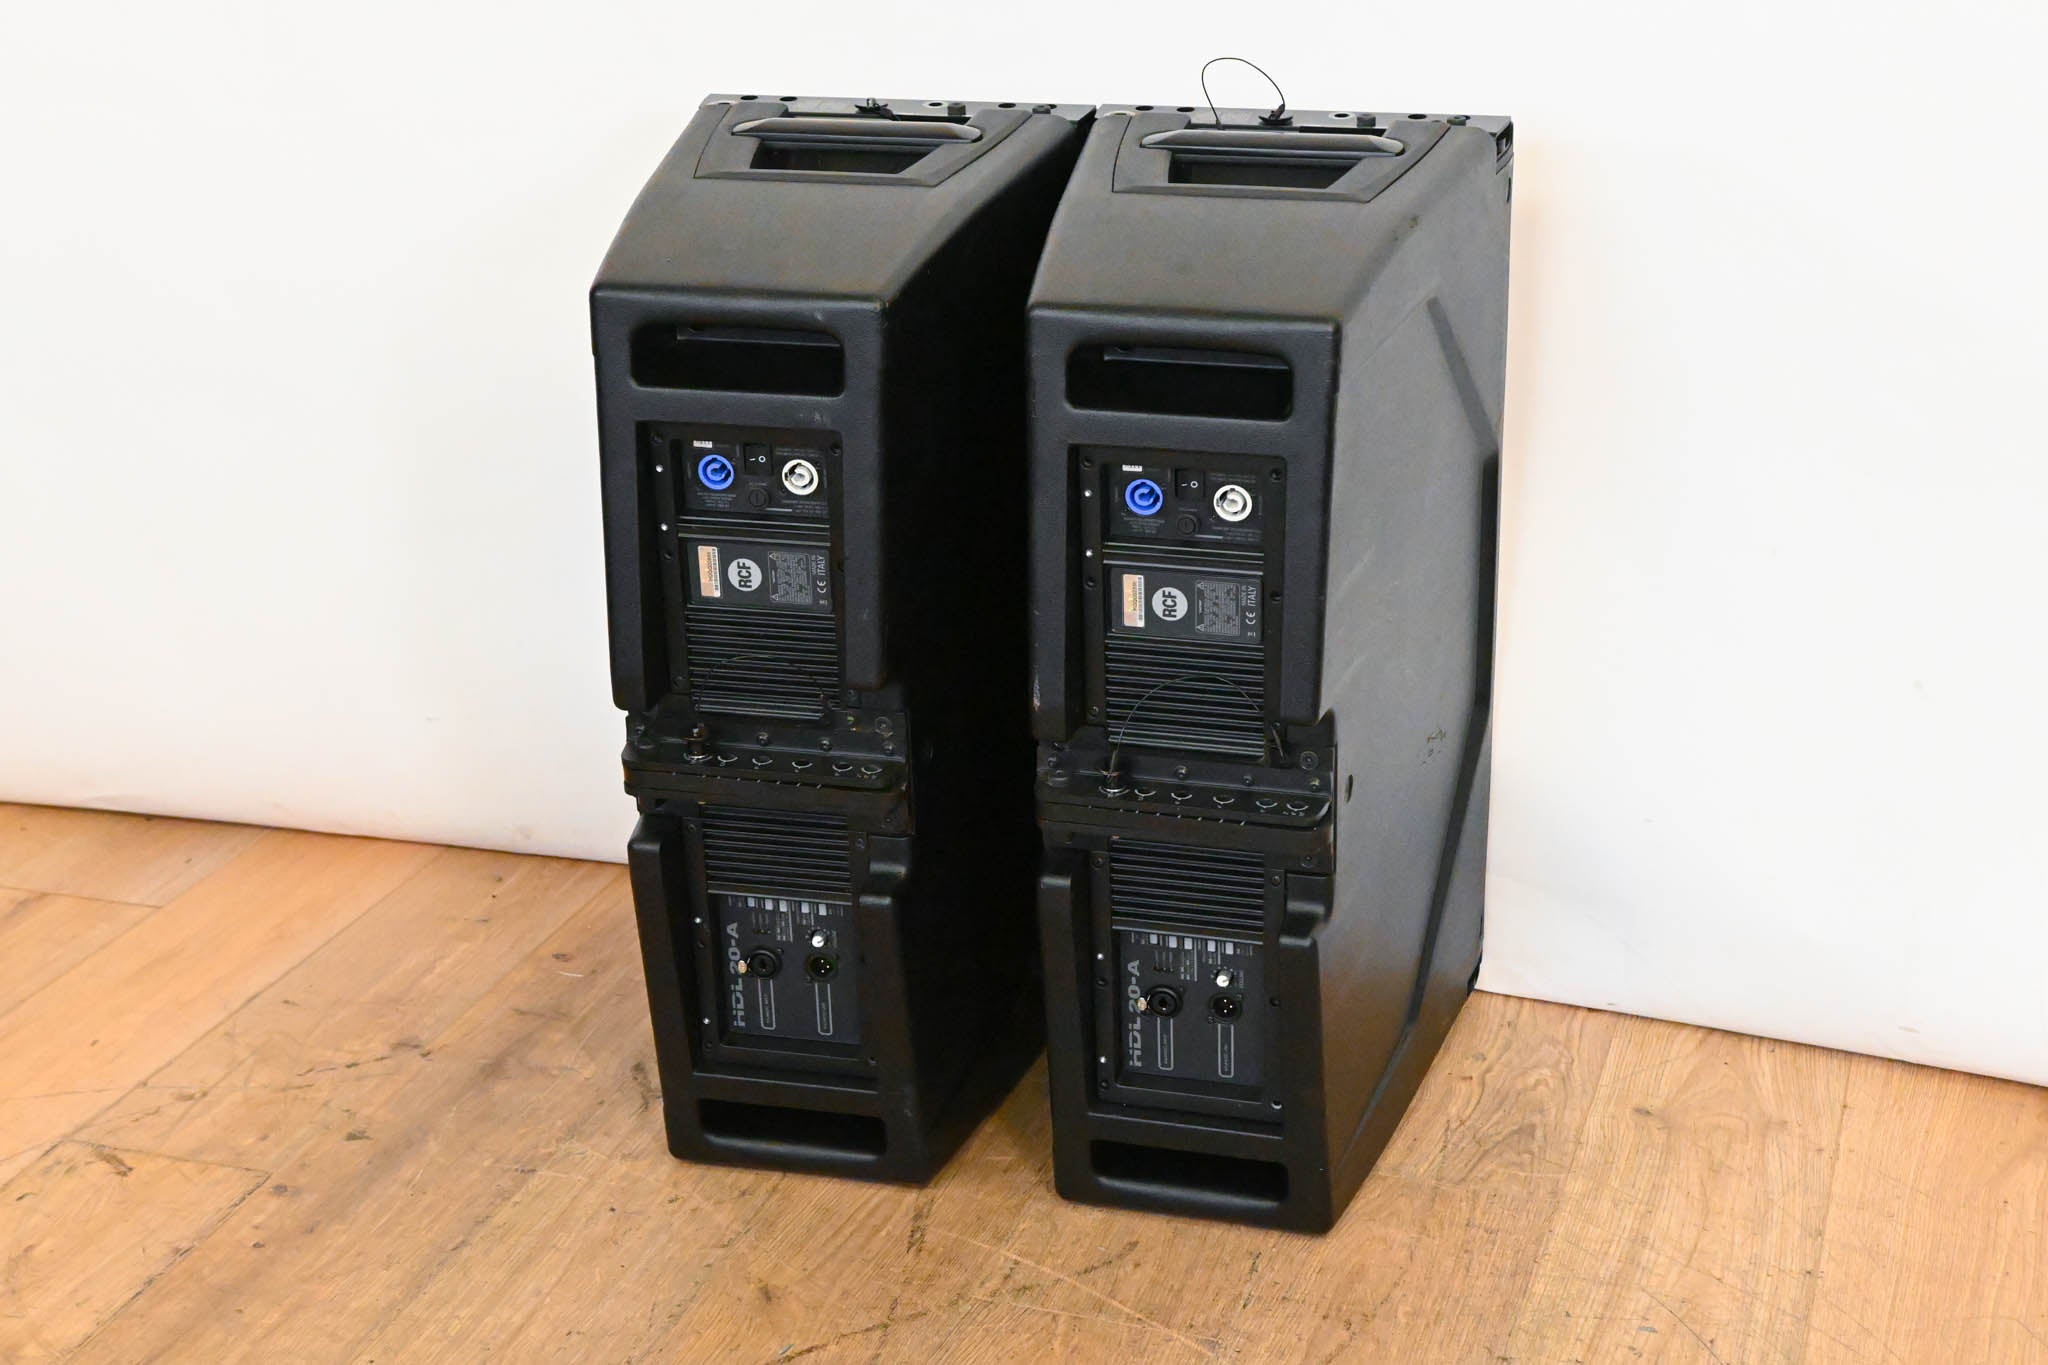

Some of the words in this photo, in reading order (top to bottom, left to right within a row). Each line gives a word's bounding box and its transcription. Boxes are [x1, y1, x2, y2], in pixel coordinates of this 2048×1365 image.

[737, 561, 752, 589] RCF
[817, 555, 827, 576] ITALY
[1162, 589, 1177, 618] RCF
[1247, 585, 1257, 607] ITALY
[730, 977, 746, 1027] HDL
[1128, 1016, 1142, 1067] HDL
